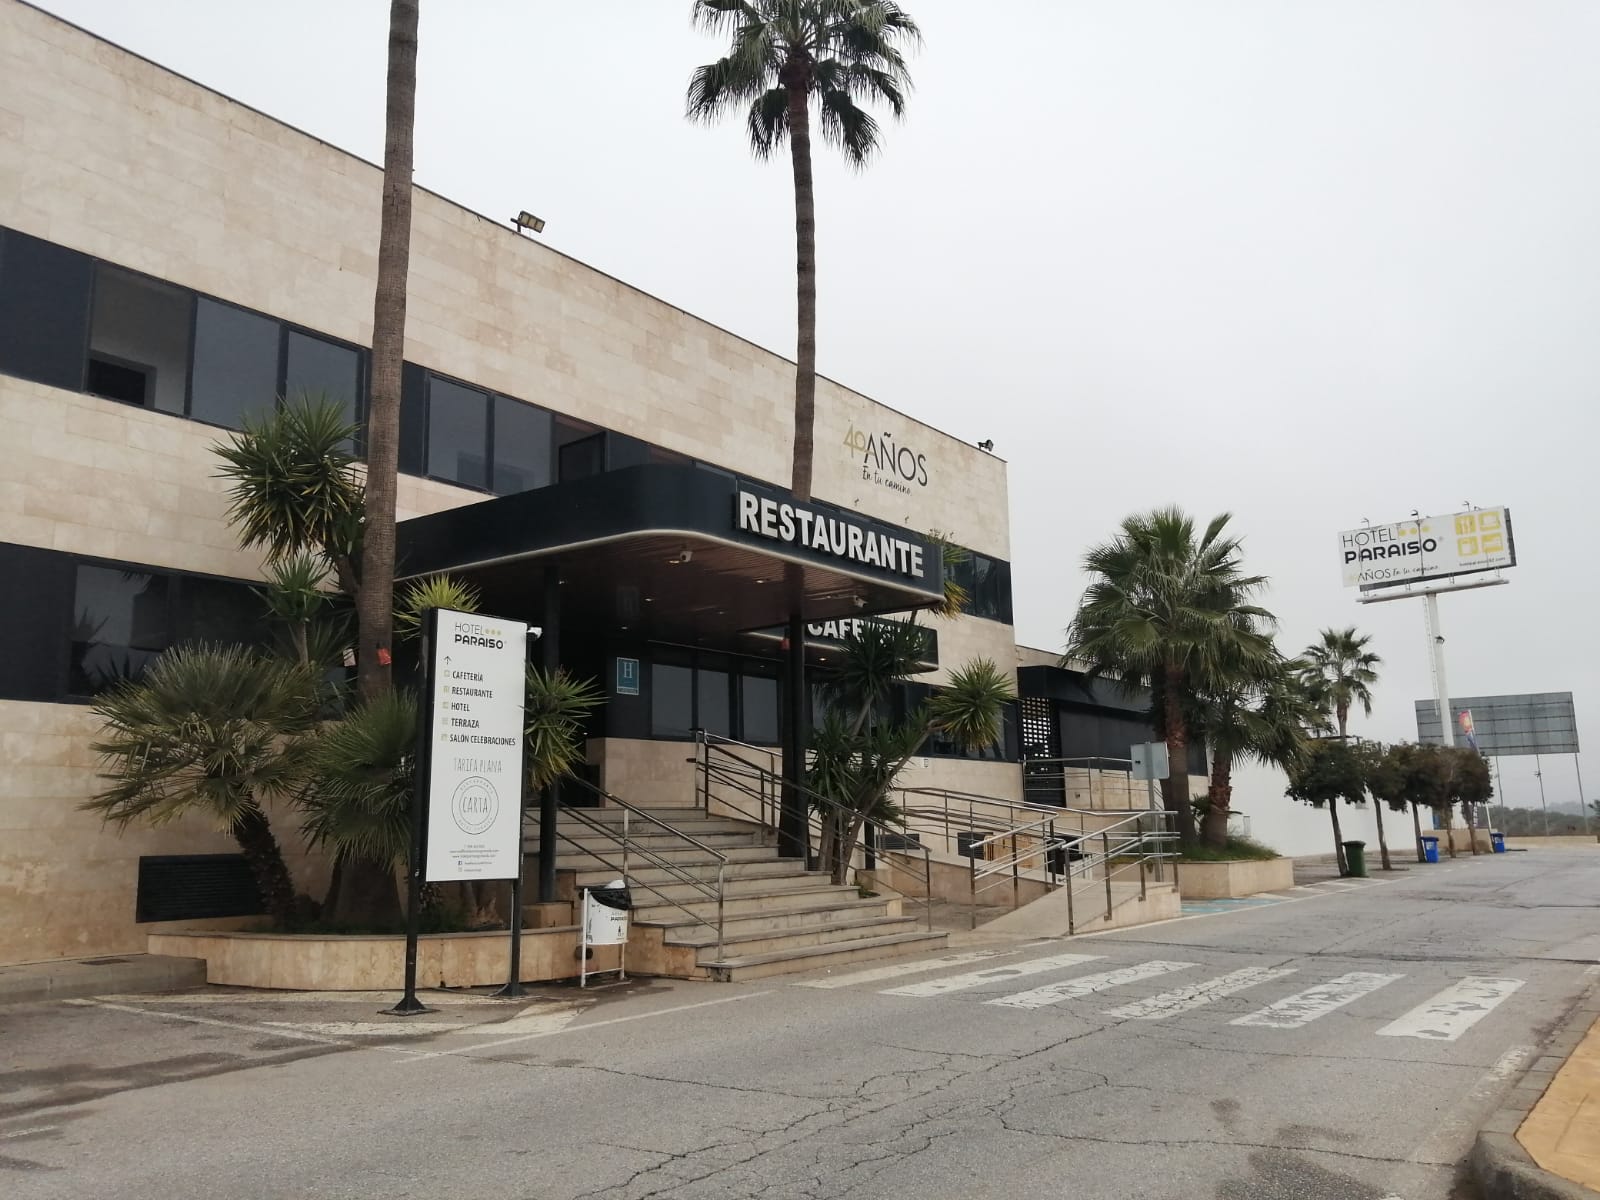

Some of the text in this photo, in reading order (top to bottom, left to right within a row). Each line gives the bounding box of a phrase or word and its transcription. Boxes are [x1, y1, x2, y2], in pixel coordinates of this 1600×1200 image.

[864, 432, 927, 486] AÑOS
[863, 466, 871, 480] En
[874, 470, 882, 485] tu
[739, 491, 924, 578] RESTAURANTE
[1343, 528, 1397, 548] HOTEL
[1345, 539, 1437, 564] PARAISO
[1358, 568, 1391, 583] AÑOS
[454, 622, 484, 636] HOTEL
[454, 634, 504, 649] PARAISO
[452, 670, 484, 682] CAFETERÍA
[451, 686, 493, 699] RESTAURANTE
[451, 702, 471, 712] HOTEL
[450, 718, 480, 729] TERRAZA
[470, 735, 516, 746] CELEBRACIONES
[462, 797, 488, 814] CARTA
